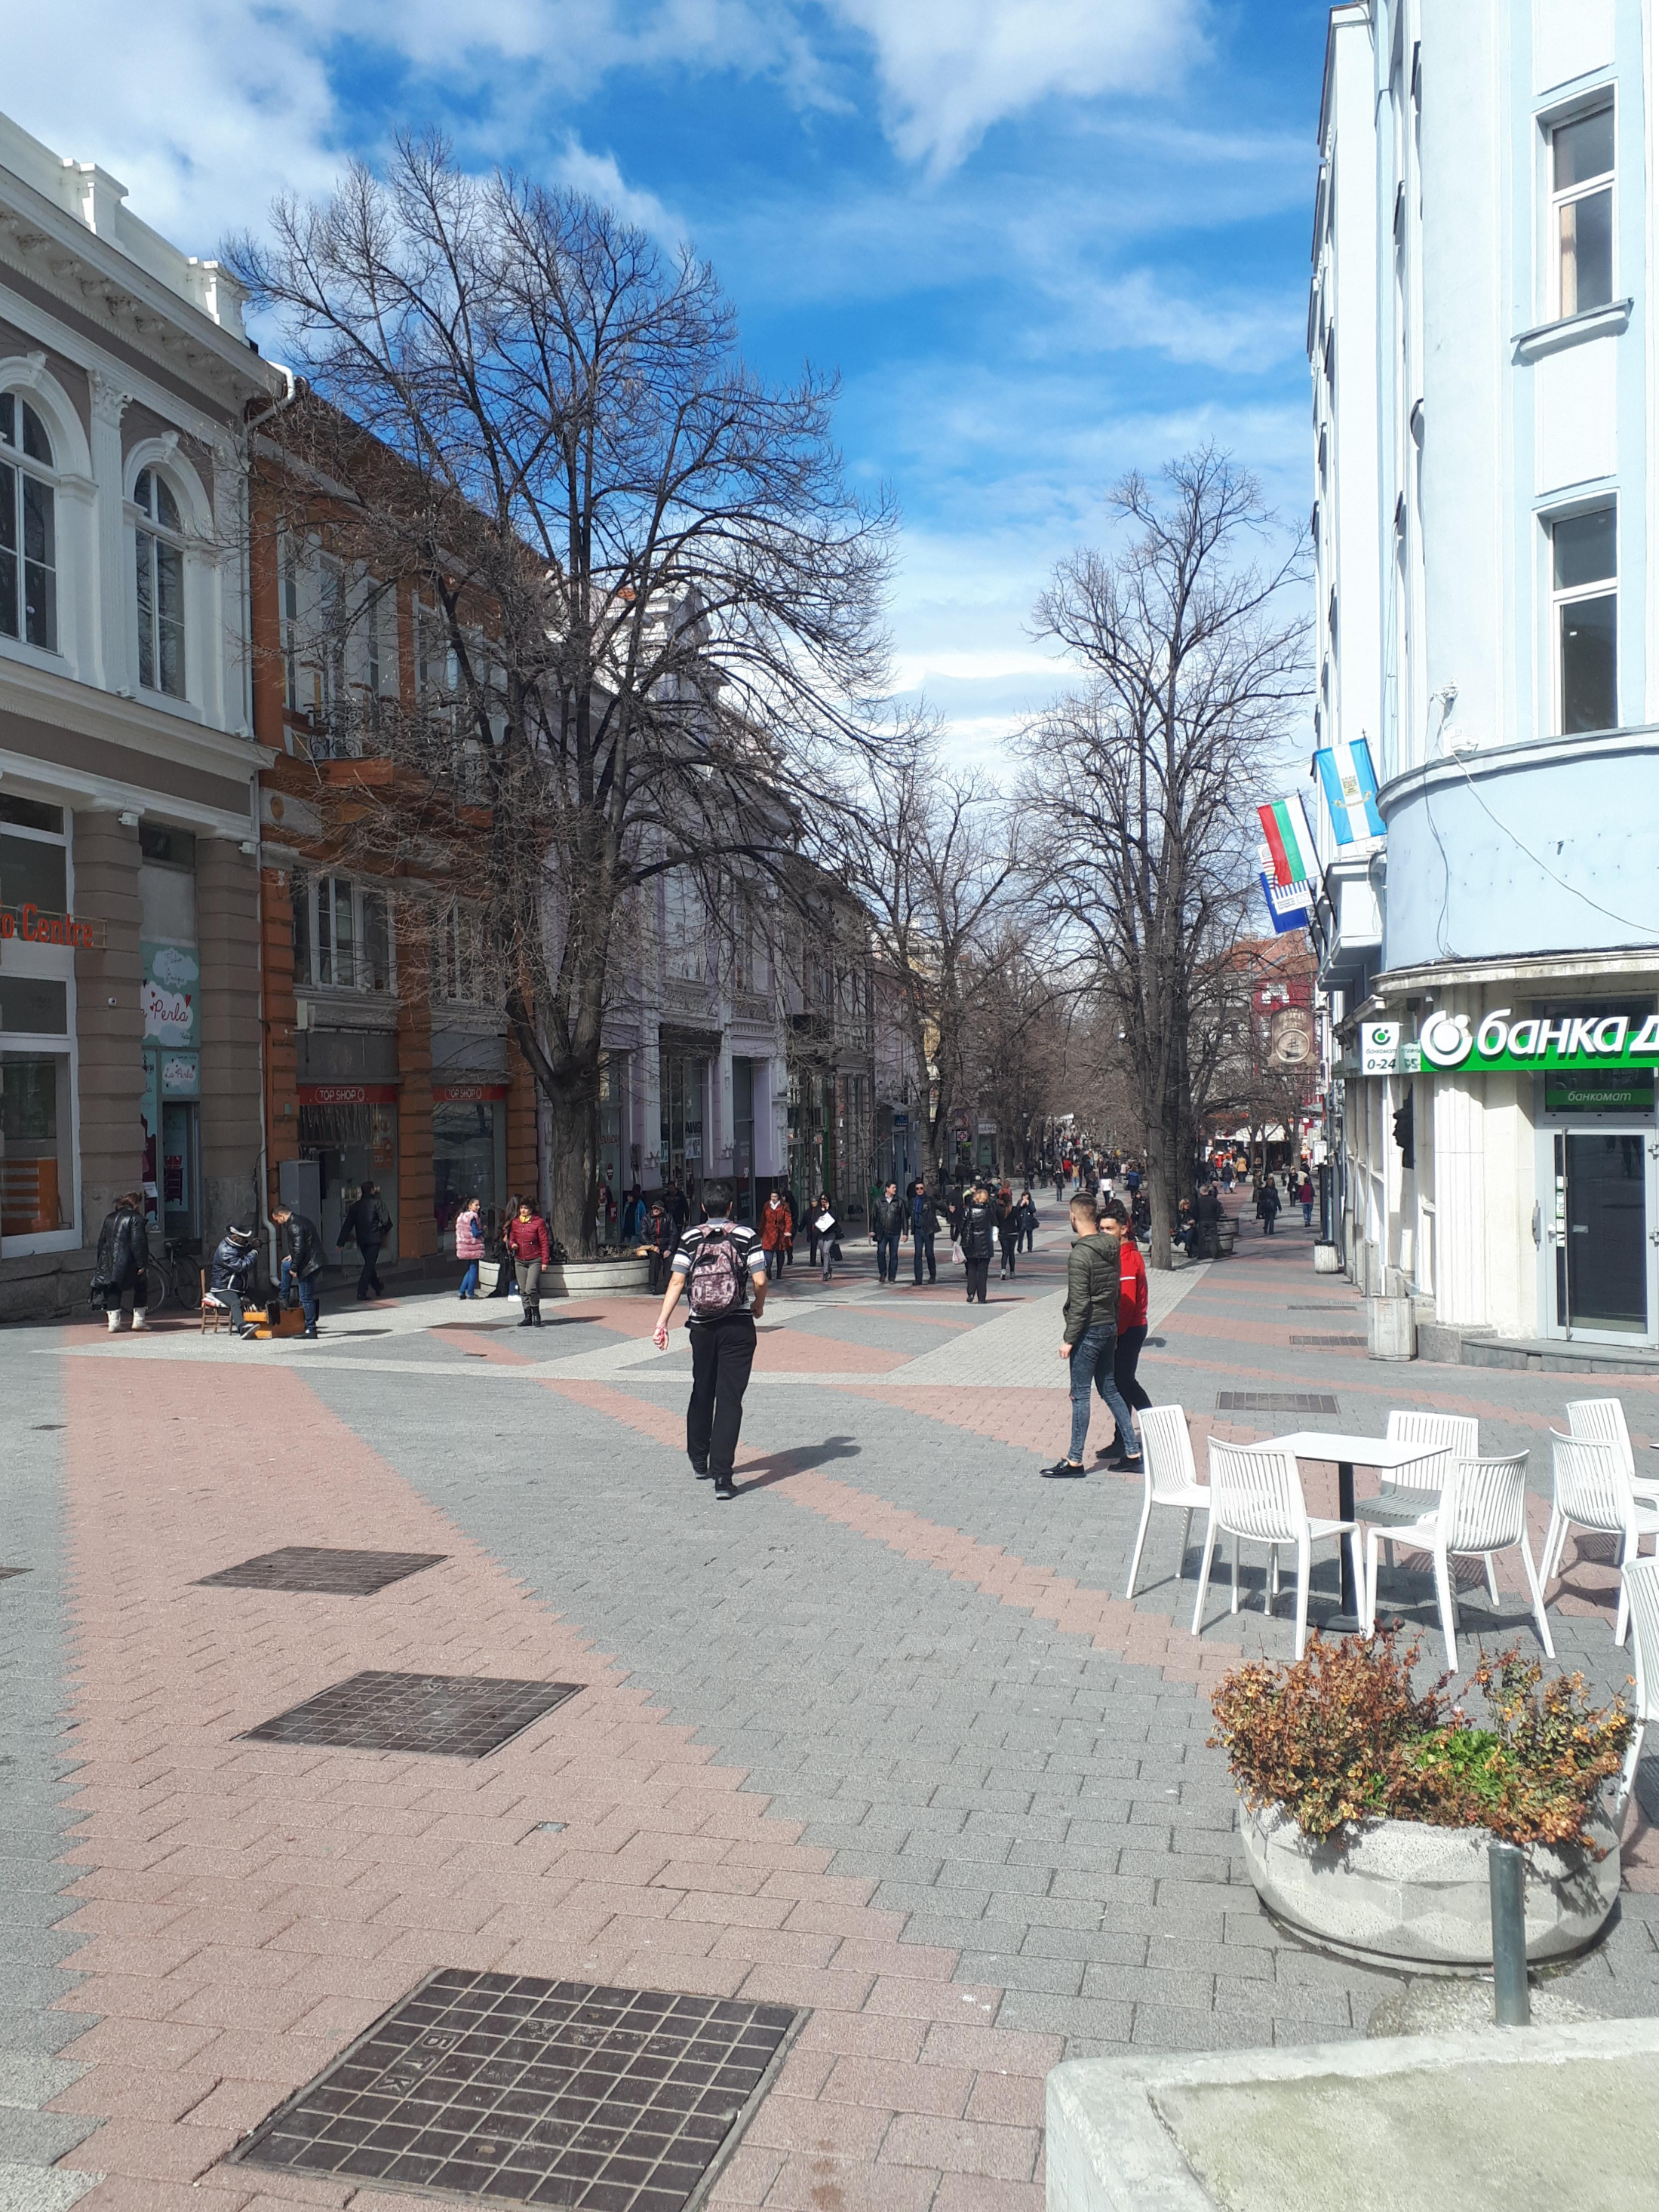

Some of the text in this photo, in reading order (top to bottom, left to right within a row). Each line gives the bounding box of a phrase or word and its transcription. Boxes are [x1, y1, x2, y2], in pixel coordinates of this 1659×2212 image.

[22, 902, 94, 949] Centre
[153, 999, 189, 1022] Perla
[1477, 1008, 1628, 1055] банка
[1367, 1058, 1396, 1070] 0-24
[176, 1068, 194, 1079] Perla
[320, 1089, 356, 1101] TOP SHOP
[448, 1088, 476, 1098] TOP SHOP
[1568, 1090, 1632, 1102] банкомат
